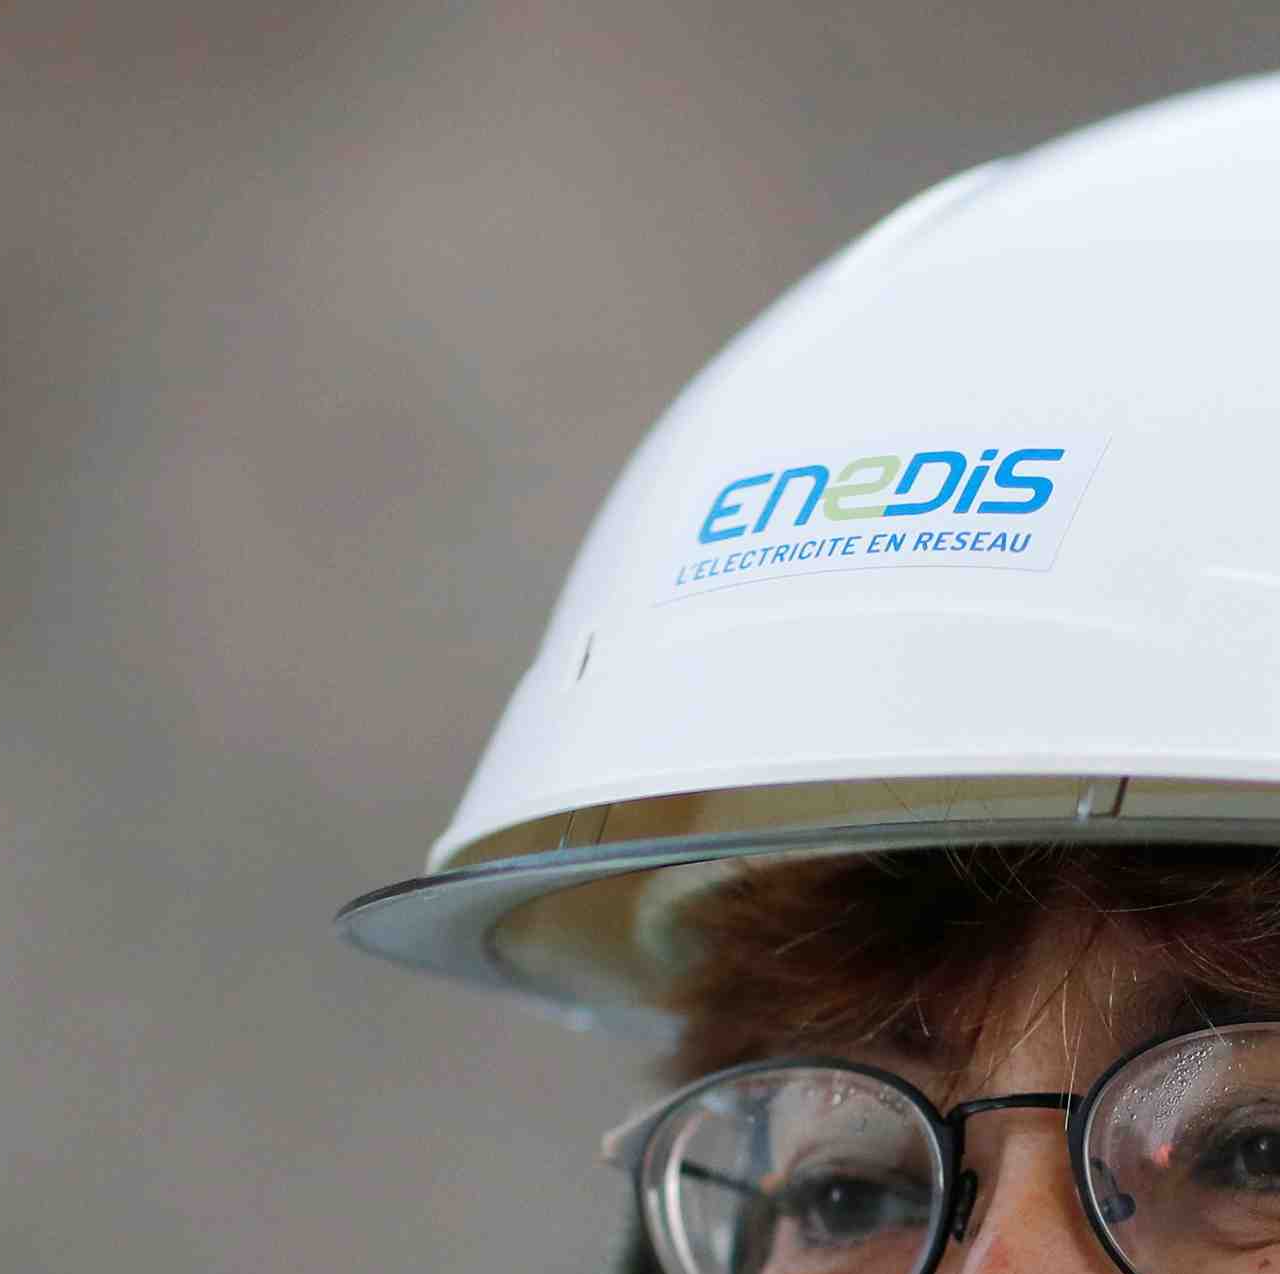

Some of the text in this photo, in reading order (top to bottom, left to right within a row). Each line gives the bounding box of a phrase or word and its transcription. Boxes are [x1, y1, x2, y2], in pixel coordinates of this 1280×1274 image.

[676, 531, 1032, 586] L'ELECTRICITE EN RESEAU
